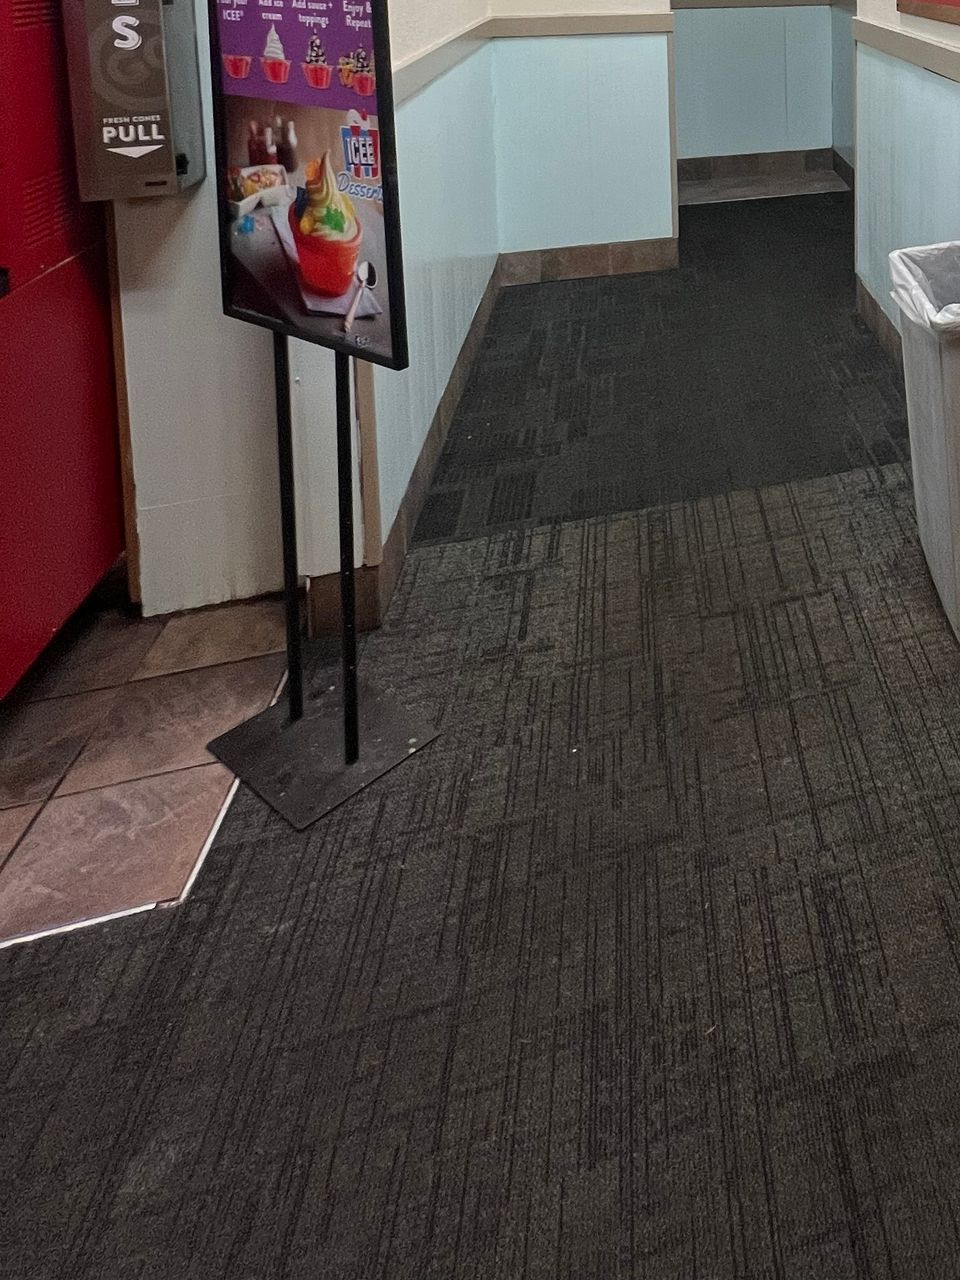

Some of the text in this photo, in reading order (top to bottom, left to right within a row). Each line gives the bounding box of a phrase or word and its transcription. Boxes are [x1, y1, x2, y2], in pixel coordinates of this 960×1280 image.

[307, 2, 327, 10] sauce
[343, 0, 364, 18] Enjoy
[262, 12, 283, 21] cream
[298, 12, 329, 29] toppings
[345, 14, 372, 32] Repeat
[132, 114, 160, 122] CONES
[102, 123, 165, 144] PULL
[346, 137, 376, 166] ICEE
